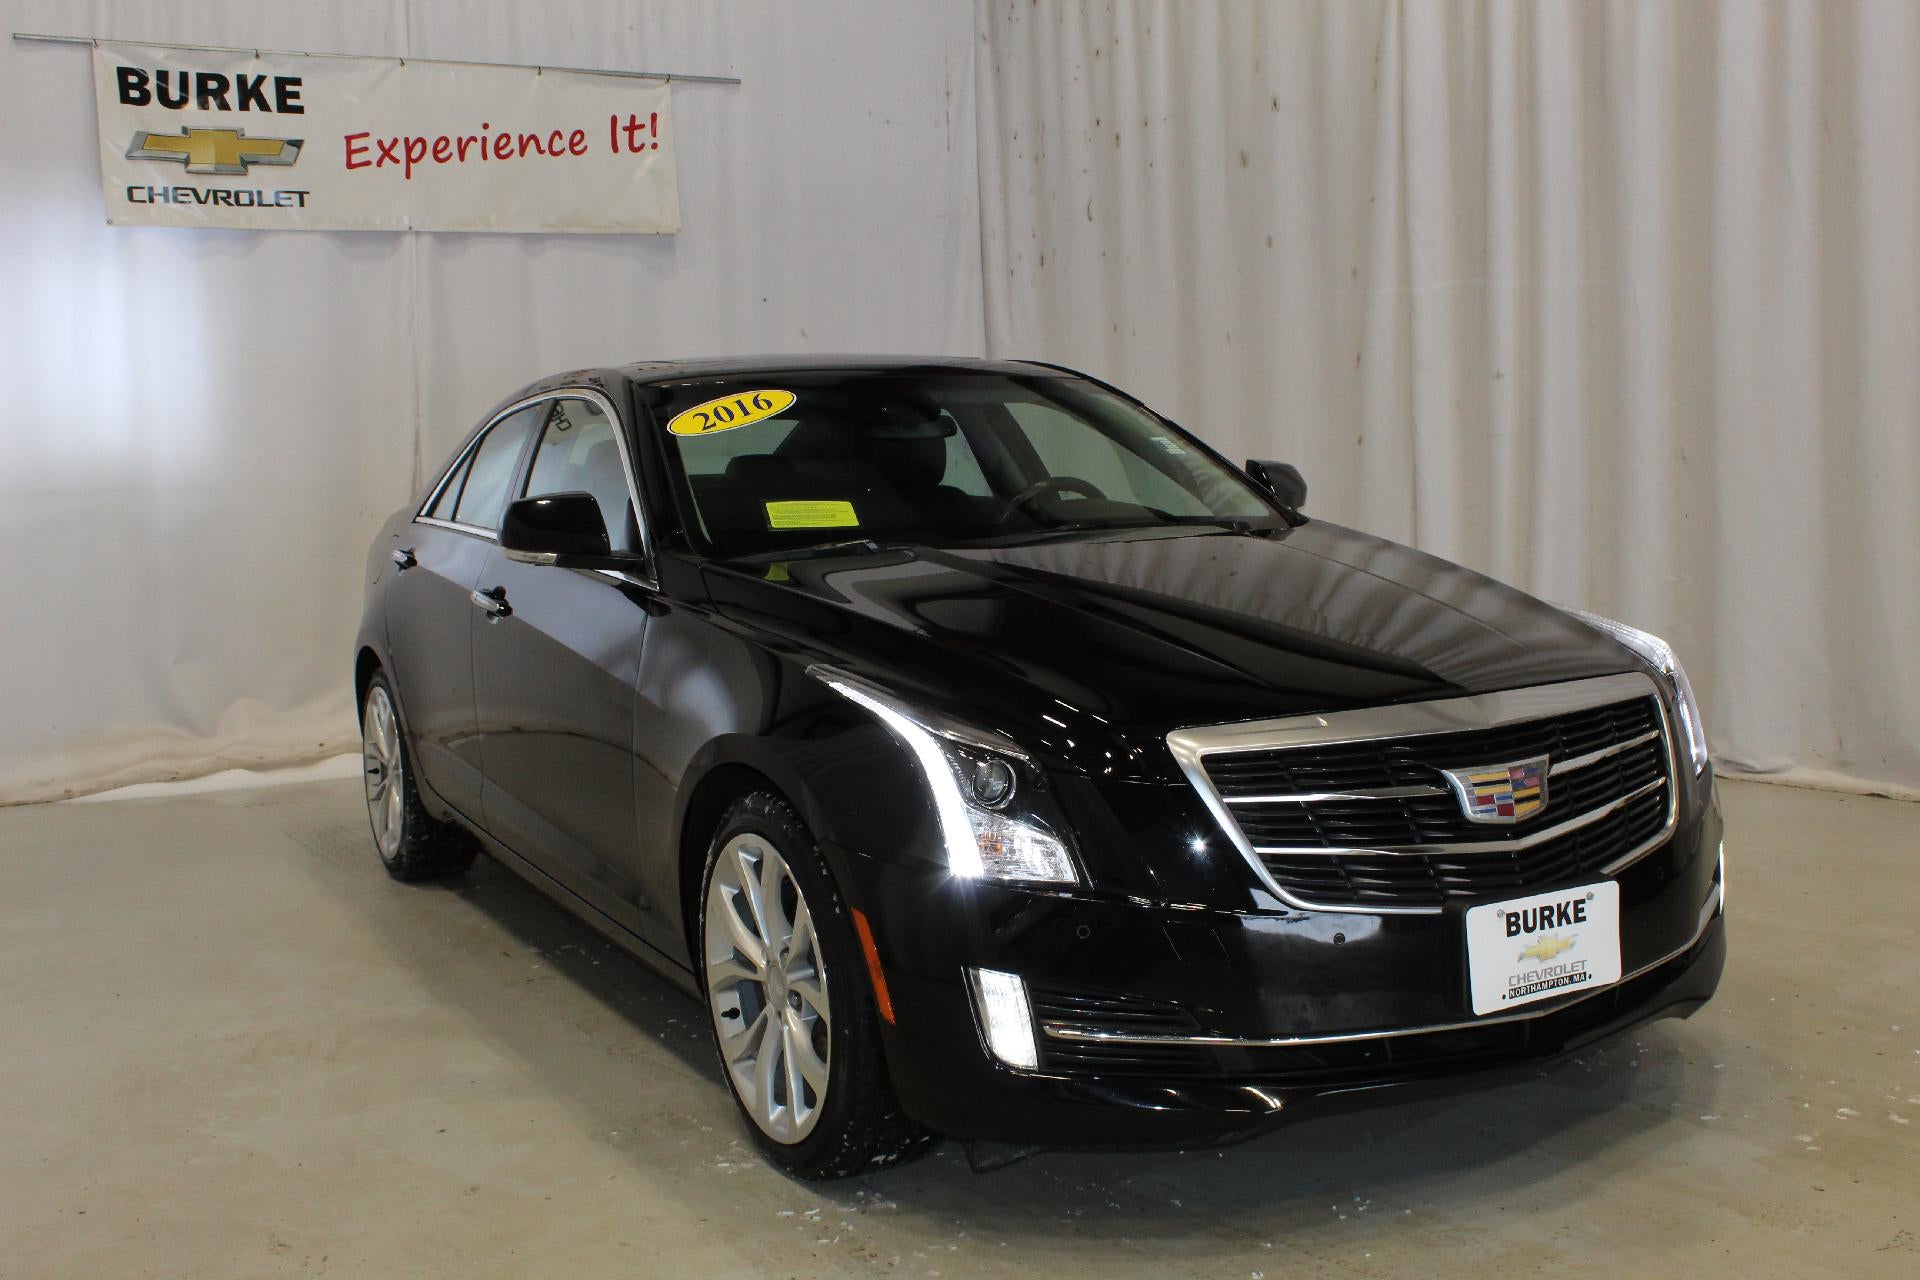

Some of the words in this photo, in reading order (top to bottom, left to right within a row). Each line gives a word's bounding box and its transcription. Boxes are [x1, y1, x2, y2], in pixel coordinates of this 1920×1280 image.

[116, 66, 305, 115] BURKE
[343, 122, 588, 180] Experience
[610, 112, 659, 154] It!
[127, 185, 310, 208] CHEVROLET
[692, 393, 773, 431] 2016
[1505, 898, 1587, 937] BURKE
[1508, 959, 1588, 987] CHEVROLET
[1573, 972, 1586, 983] MA
